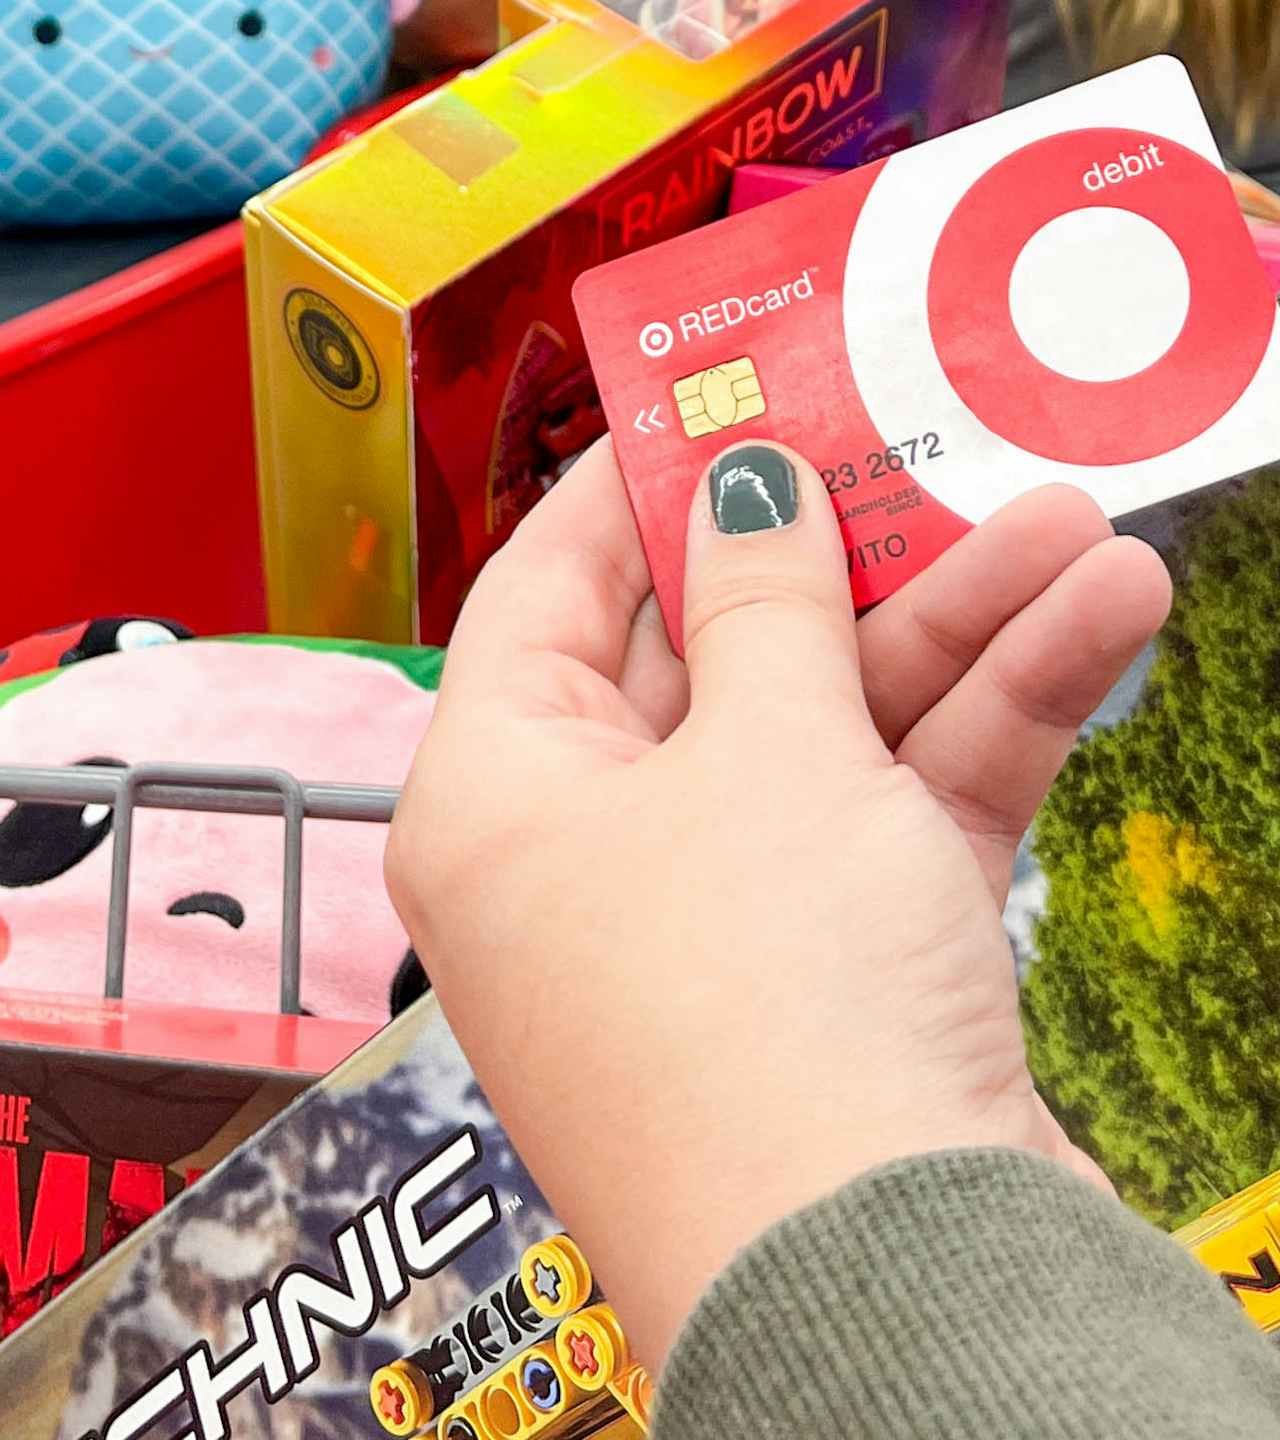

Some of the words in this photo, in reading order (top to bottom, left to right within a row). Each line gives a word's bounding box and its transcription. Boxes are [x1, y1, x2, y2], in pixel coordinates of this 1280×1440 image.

[621, 45, 864, 247] RAINBOW
[1083, 142, 1165, 192] debit
[678, 269, 814, 343] REDcard
[820, 462, 858, 495] 23
[866, 431, 944, 480] 2672
[90, 1128, 498, 1440] CHNIC
